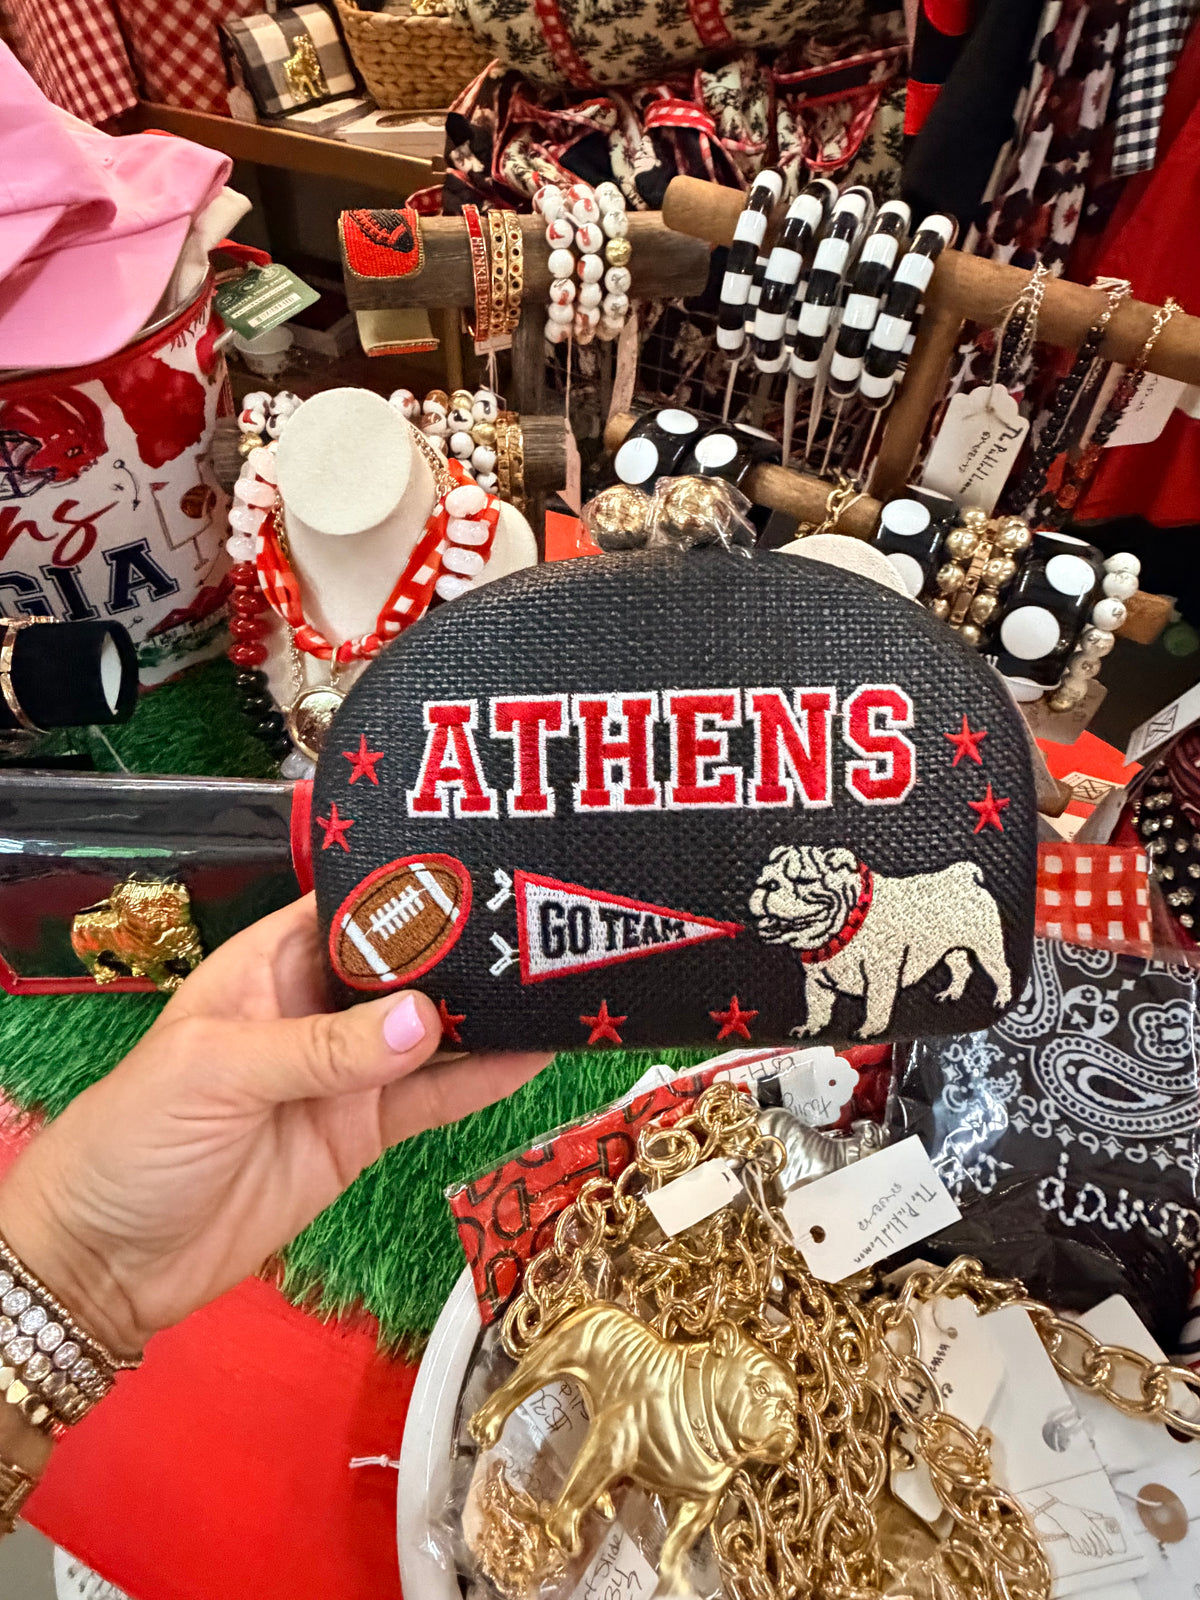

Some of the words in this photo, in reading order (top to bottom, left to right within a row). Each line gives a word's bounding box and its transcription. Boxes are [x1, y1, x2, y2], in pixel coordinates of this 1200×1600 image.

[405, 683, 918, 818] ATHENS
[539, 901, 591, 959] GO
[600, 908, 687, 951] TEAM
[911, 1183, 938, 1203] The
[881, 1202, 920, 1245] Pickled
[853, 1235, 889, 1264] Lemon
